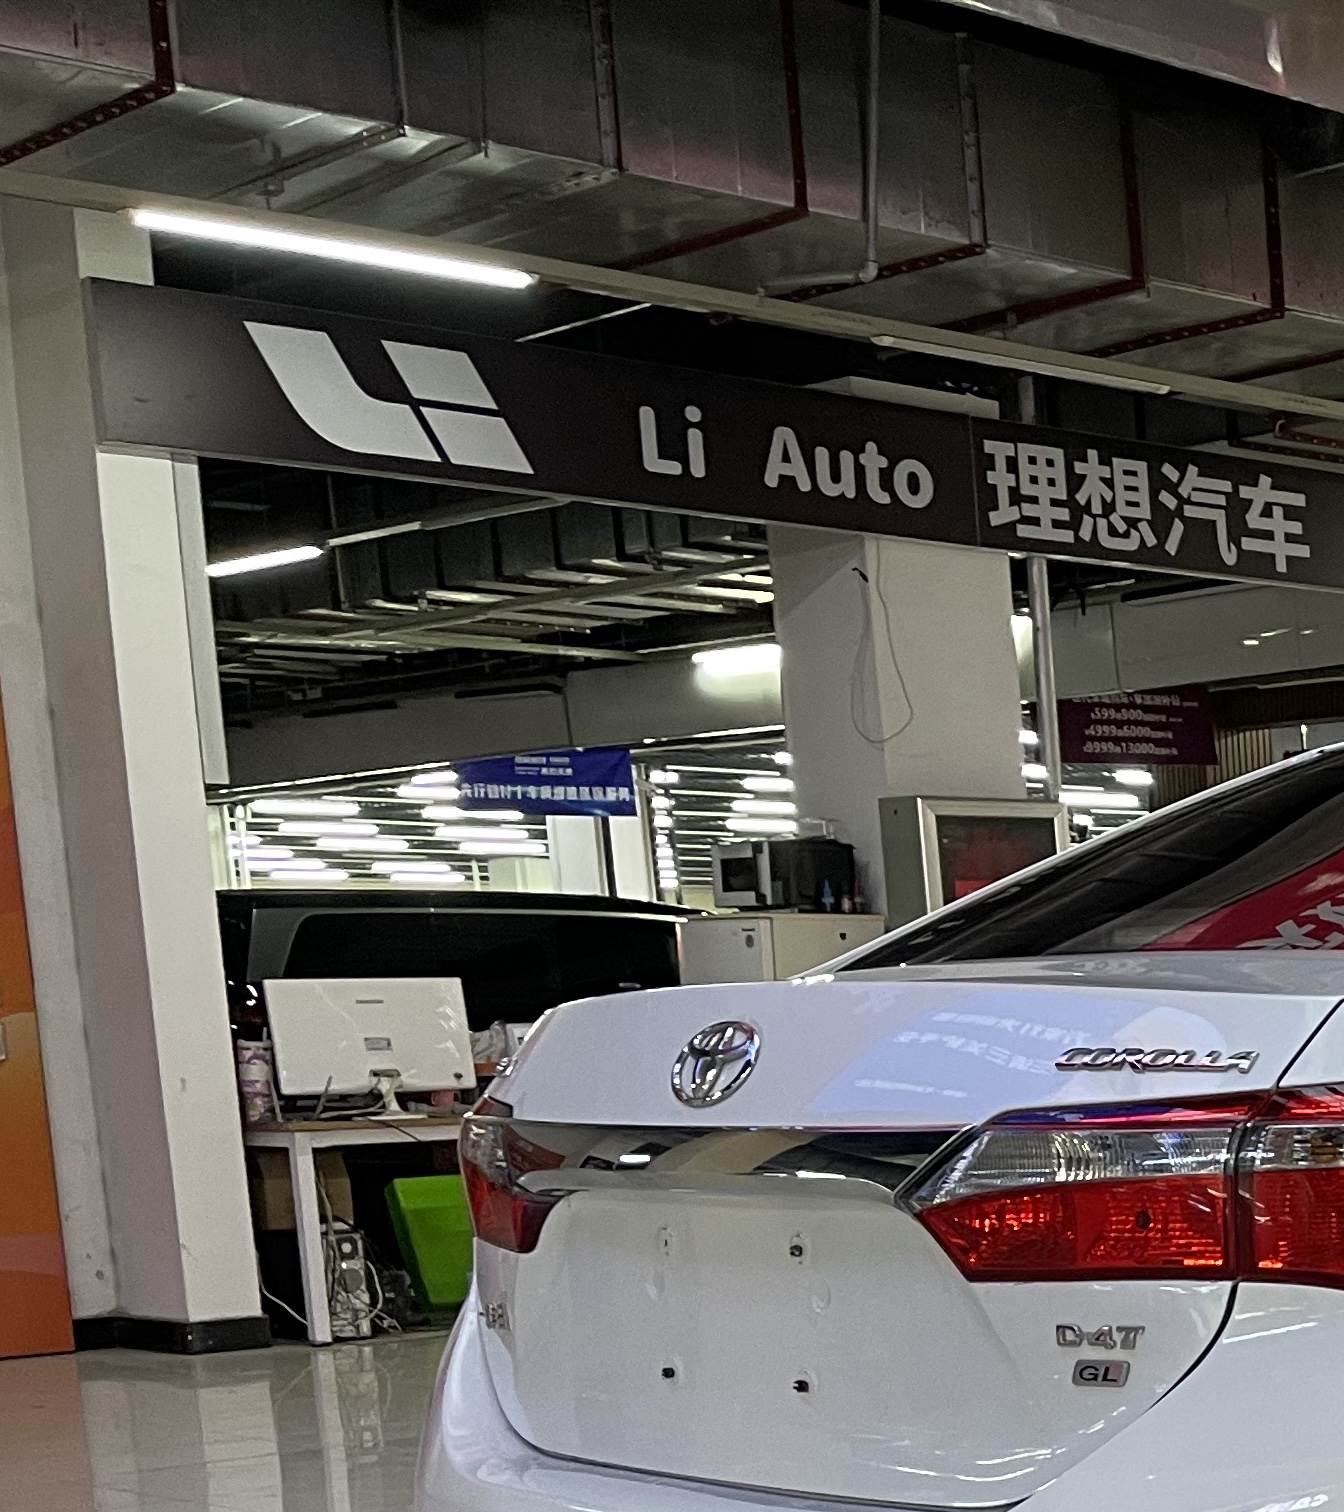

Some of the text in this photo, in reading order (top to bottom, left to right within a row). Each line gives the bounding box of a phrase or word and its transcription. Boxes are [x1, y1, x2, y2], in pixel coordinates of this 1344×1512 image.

[639, 405, 1312, 573] Li Auto 理想汽车
[1055, 1047, 1260, 1074] COROLLA
[1079, 1365, 1118, 1382] GL
